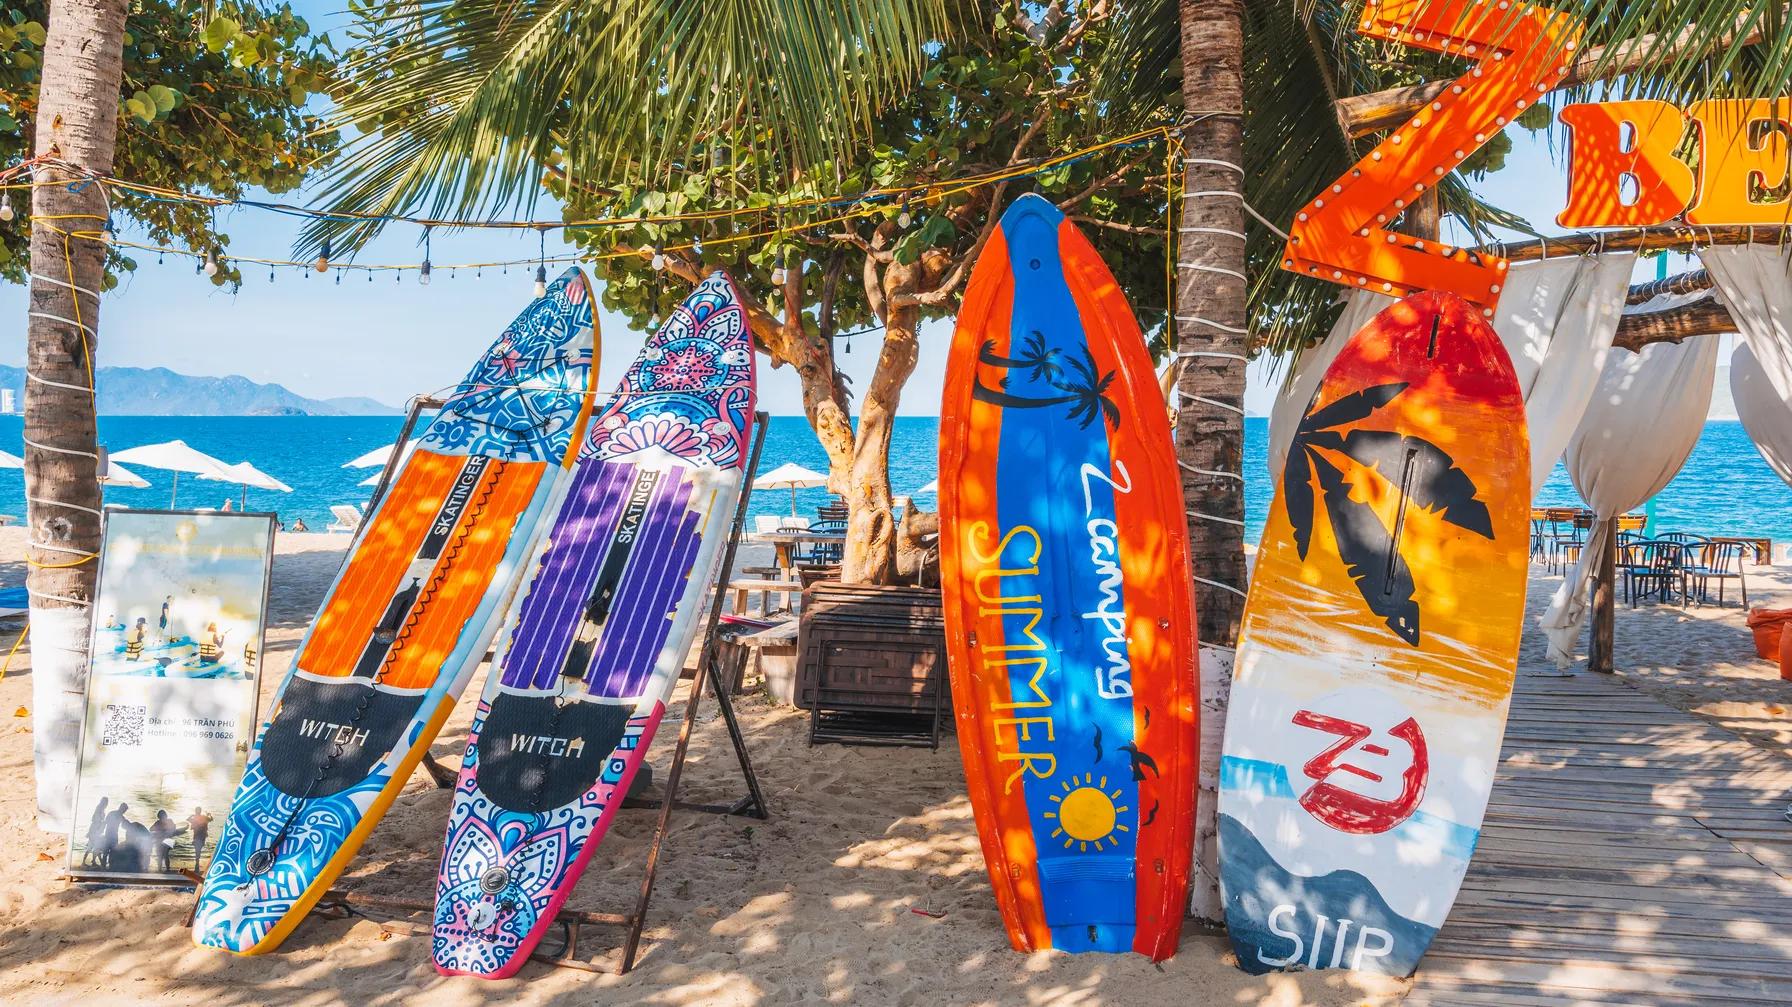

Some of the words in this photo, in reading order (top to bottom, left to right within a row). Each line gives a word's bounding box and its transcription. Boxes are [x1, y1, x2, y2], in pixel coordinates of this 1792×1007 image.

[1281, 0, 1584, 320] Z
[434, 455, 486, 536] SKATINGER
[968, 520, 1057, 796] SUMMER
[147, 729, 177, 737] Hotline
[183, 730, 198, 738] 096
[199, 731, 213, 739] 969
[215, 731, 234, 740] 0626
[148, 717, 162, 726] Địa
[182, 718, 192, 726] 96
[193, 717, 215, 727] TRẦN
[217, 718, 235, 728] PHÚ
[300, 719, 370, 747] WITCH
